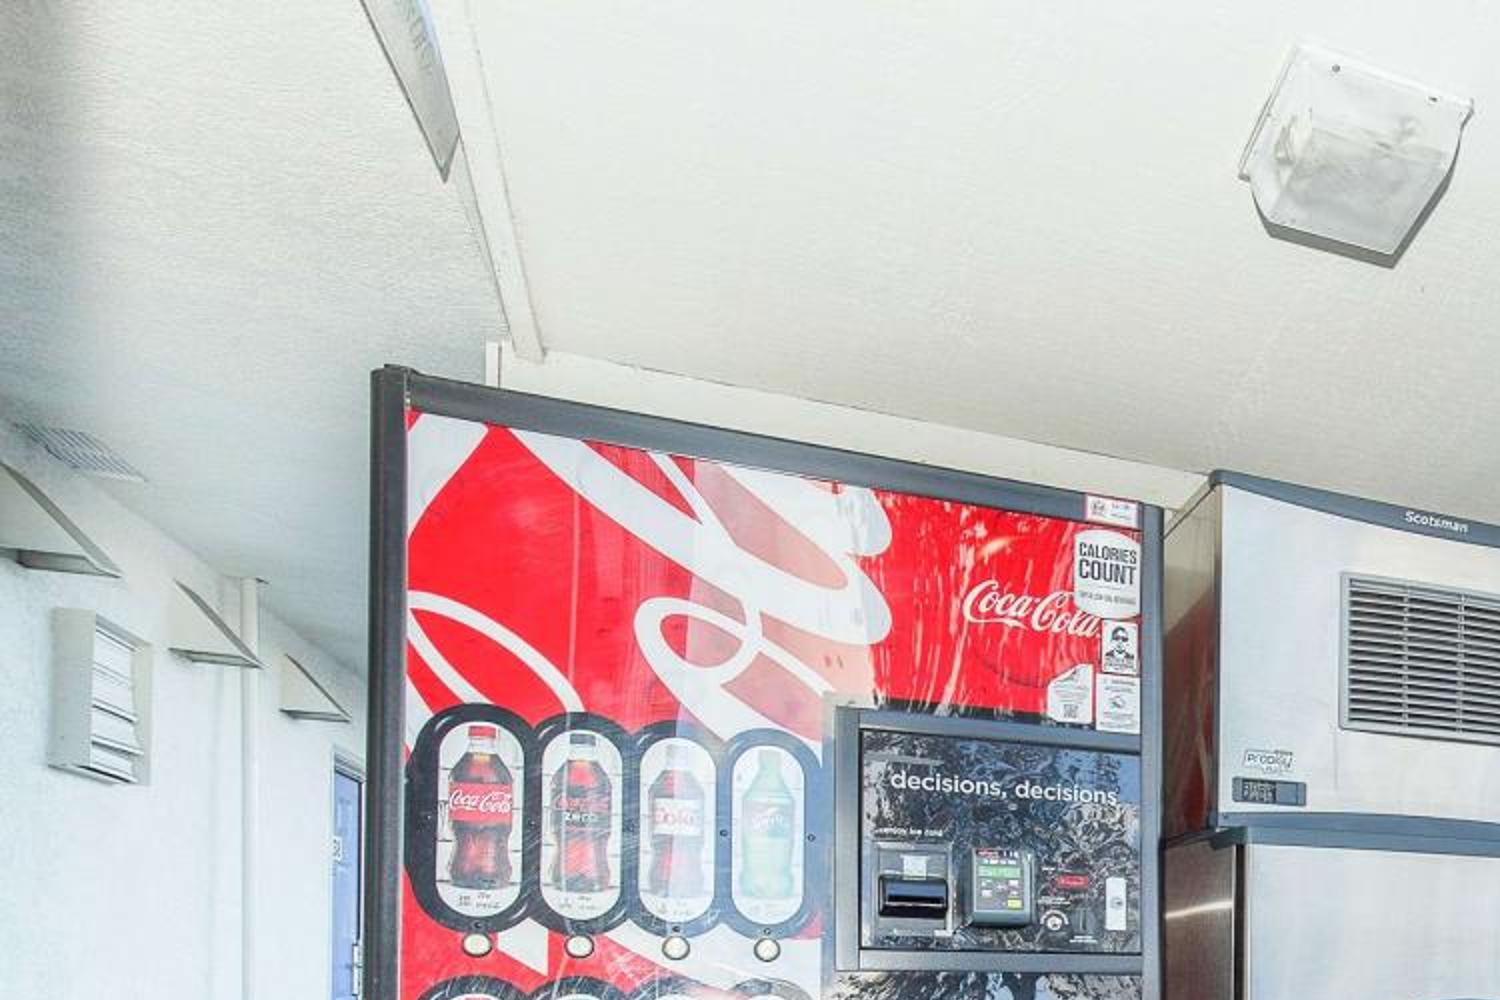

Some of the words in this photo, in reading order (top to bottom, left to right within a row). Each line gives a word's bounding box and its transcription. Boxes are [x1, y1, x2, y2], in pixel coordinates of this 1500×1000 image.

[1405, 511, 1469, 533] Scotsman
[1079, 541, 1137, 564] CALORIES
[1079, 559, 1137, 585] COUNT
[963, 579, 1101, 638] Coca-Cola
[450, 788, 512, 814] Coca-Cola
[891, 771, 1007, 799] decisions,
[1015, 780, 1119, 805] decisions
